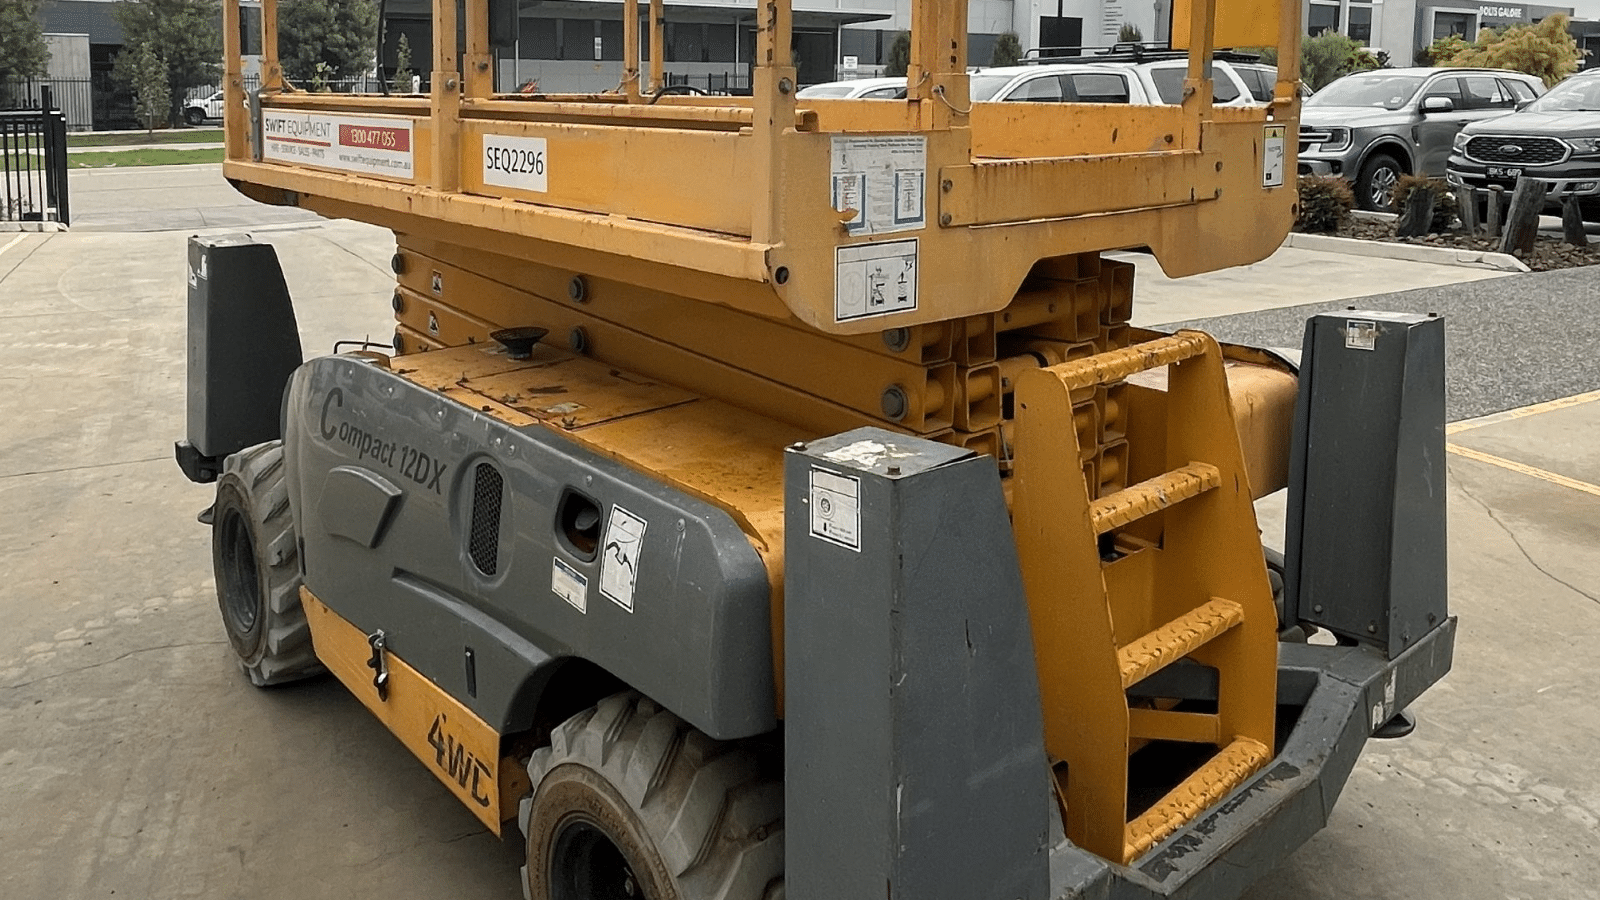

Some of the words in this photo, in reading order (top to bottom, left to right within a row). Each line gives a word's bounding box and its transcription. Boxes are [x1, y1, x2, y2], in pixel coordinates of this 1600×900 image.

[265, 118, 286, 133] SWIFT
[287, 120, 331, 137] EQUIPMENT
[350, 128, 366, 144] 1300
[367, 130, 381, 145] 477
[381, 131, 396, 147] 055
[486, 146, 544, 175] SEQ2296
[320, 386, 397, 469] Compact
[399, 445, 447, 495] 12DX
